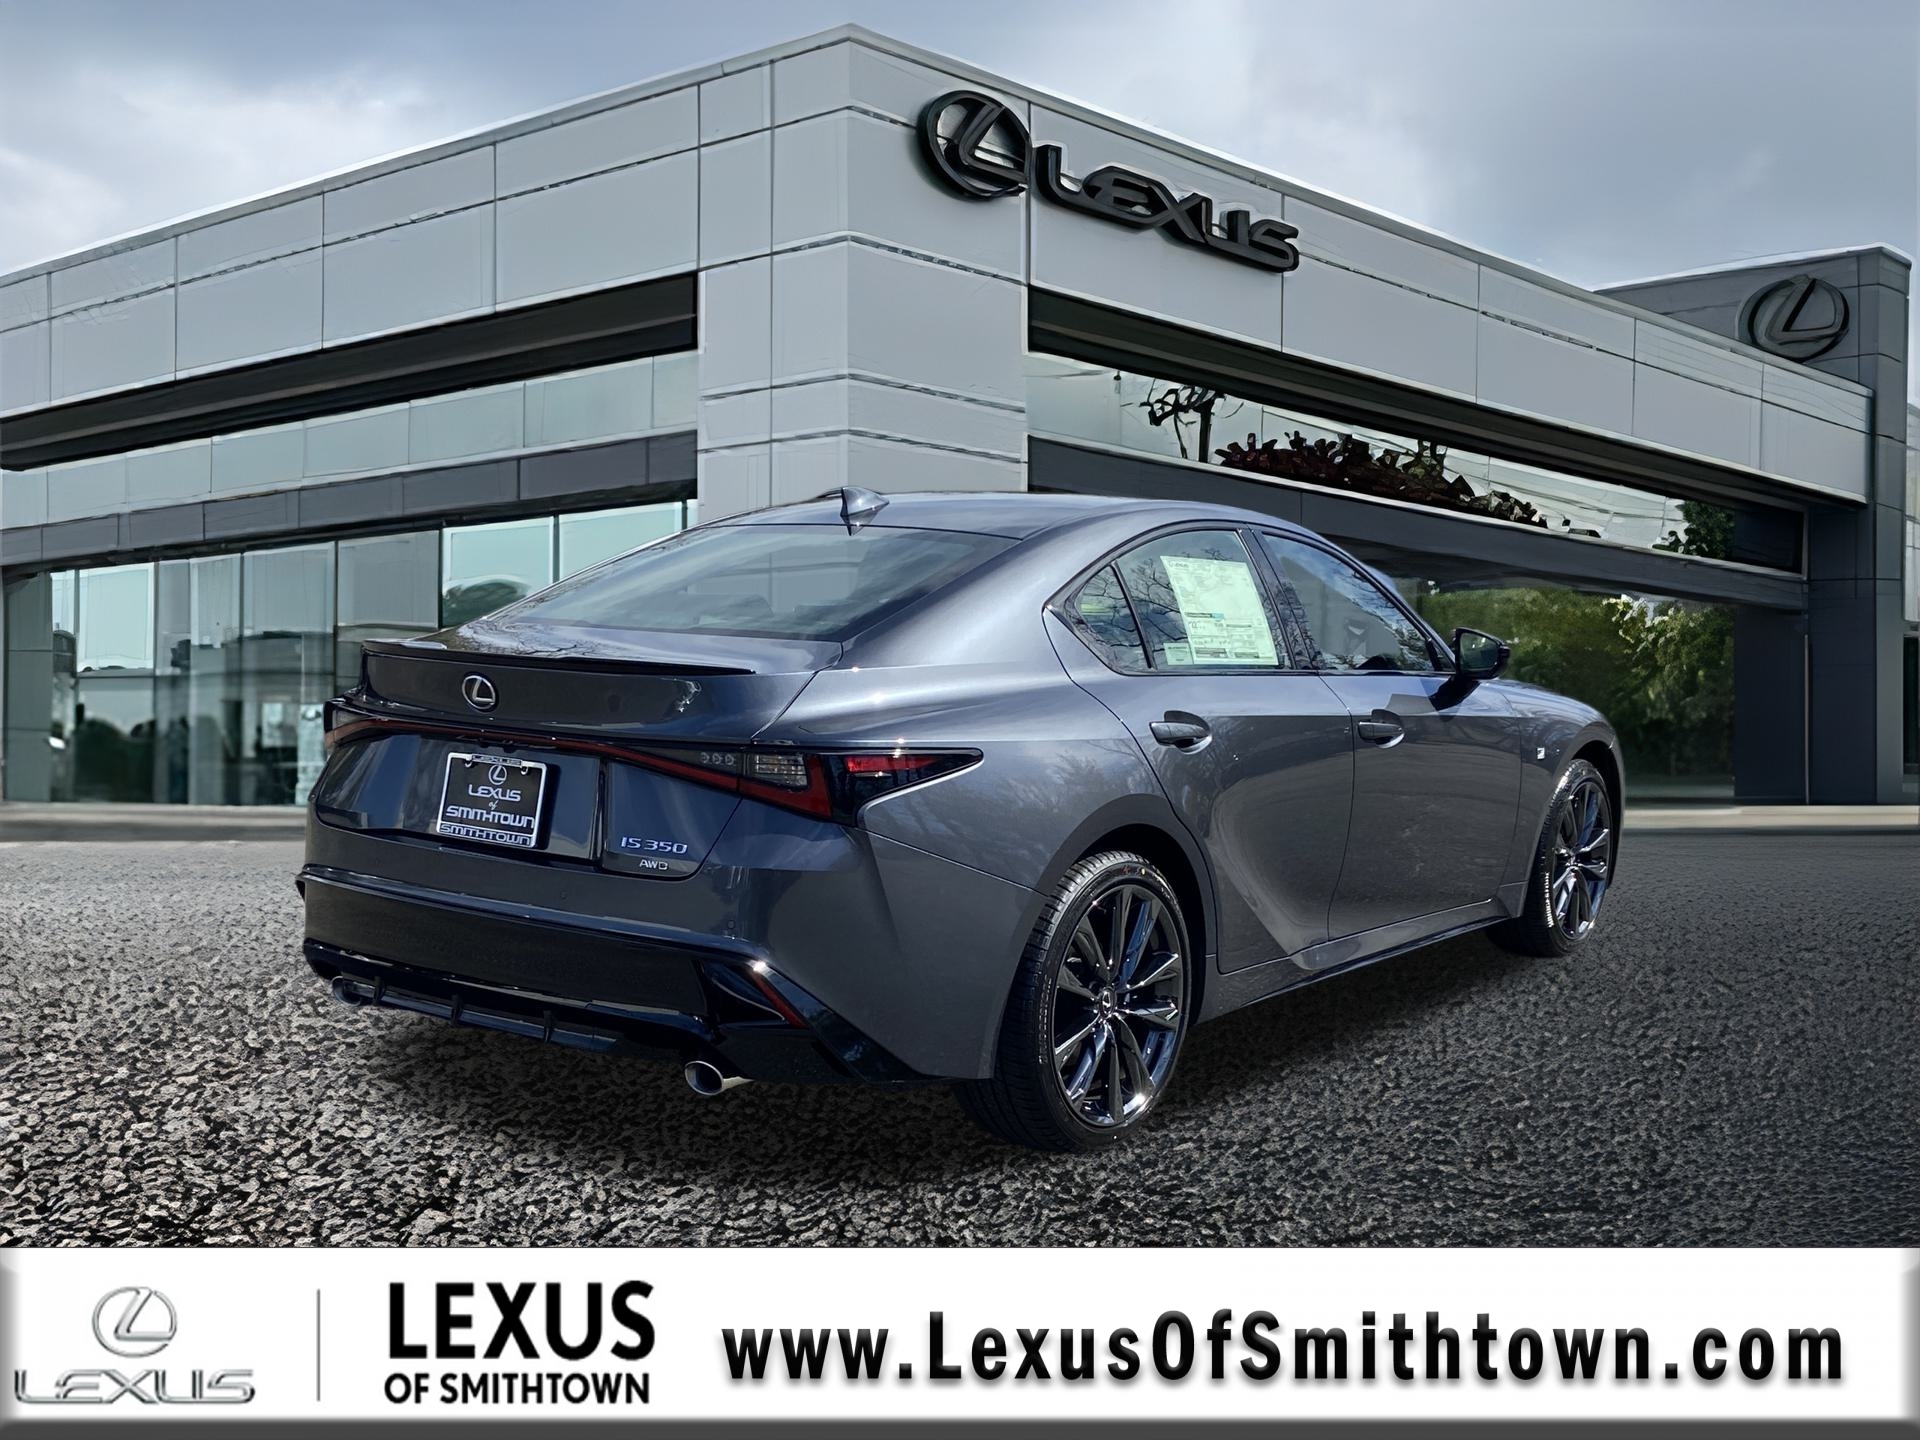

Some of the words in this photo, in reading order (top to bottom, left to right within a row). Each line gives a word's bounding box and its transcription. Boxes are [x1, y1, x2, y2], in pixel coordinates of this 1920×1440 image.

[1034, 144, 1300, 272] LEXUS
[468, 784, 521, 802] LEXUS
[488, 800, 499, 810] of
[445, 805, 535, 829] SMITHTOWN
[440, 823, 531, 845] SMITHTOWN
[621, 836, 640, 849] IS
[644, 839, 688, 855] 350
[639, 859, 668, 871] AWD
